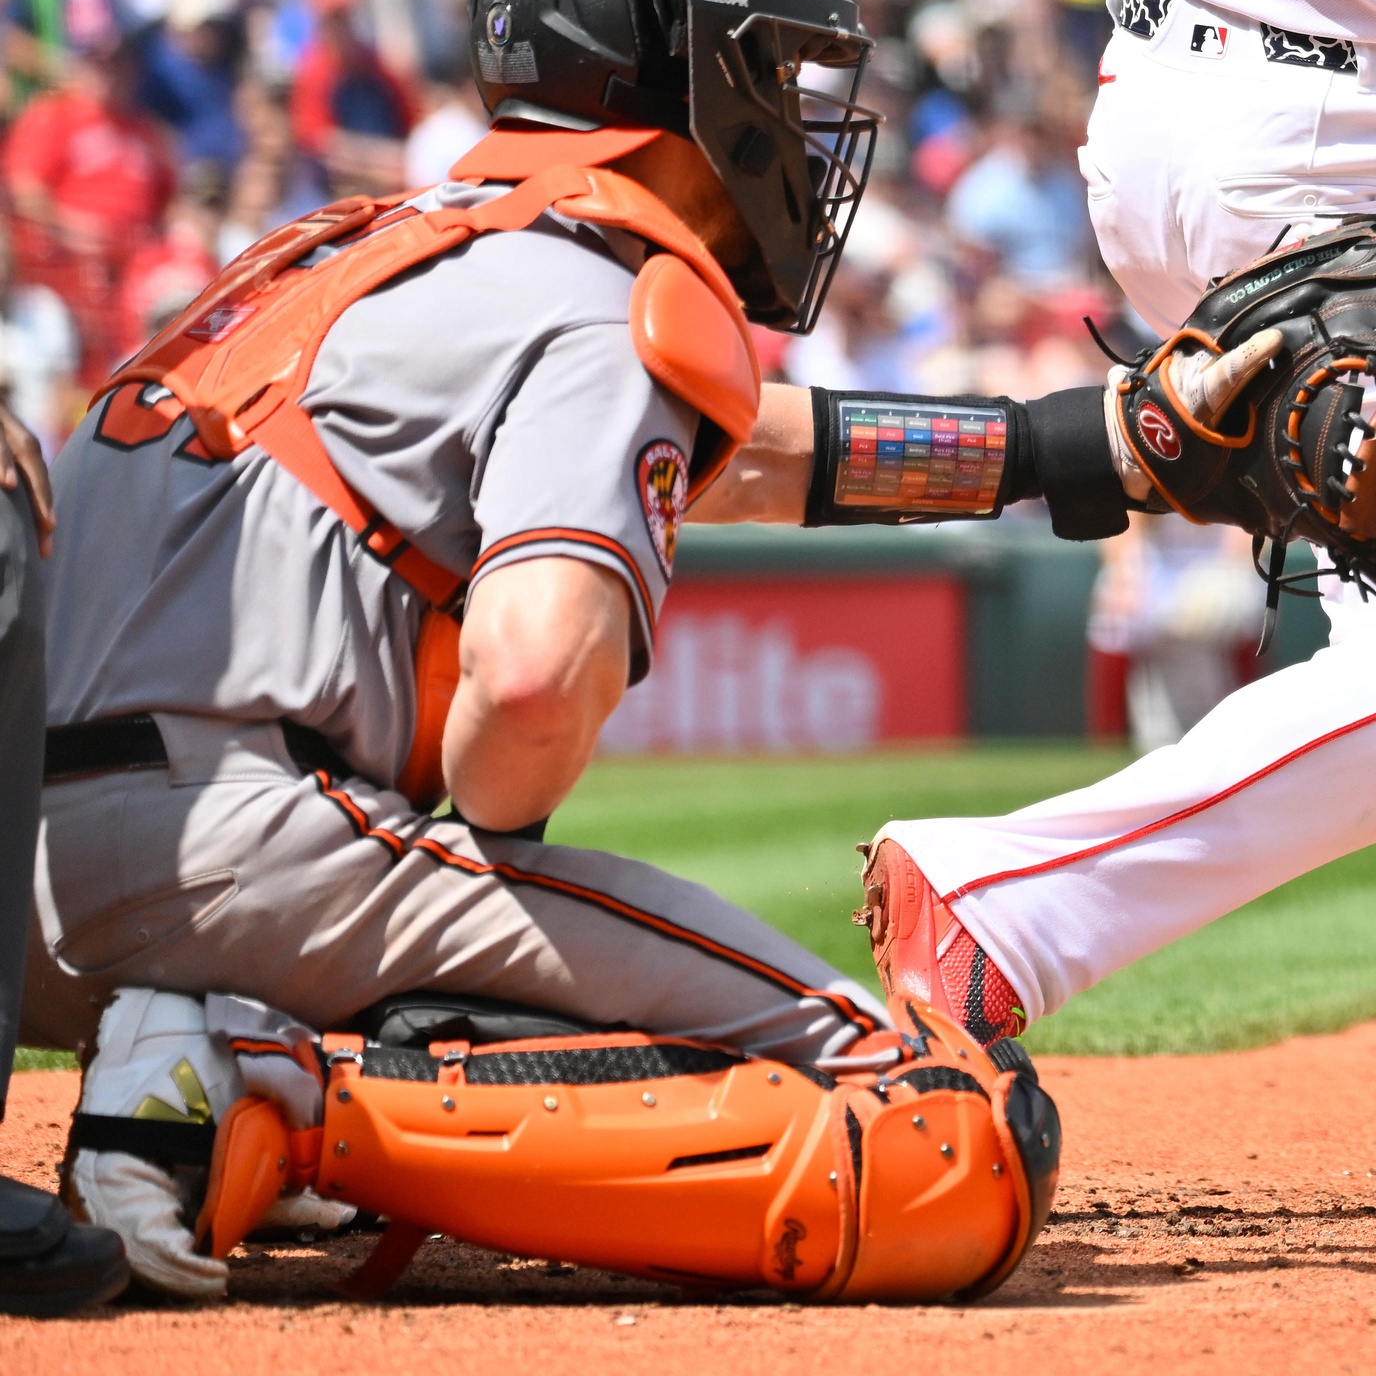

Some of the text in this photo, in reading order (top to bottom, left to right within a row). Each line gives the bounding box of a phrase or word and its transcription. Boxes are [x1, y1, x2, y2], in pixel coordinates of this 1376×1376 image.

[1317, 247, 1343, 261] THE
[1284, 255, 1316, 273] GOLD
[1245, 268, 1282, 294] GLOVE
